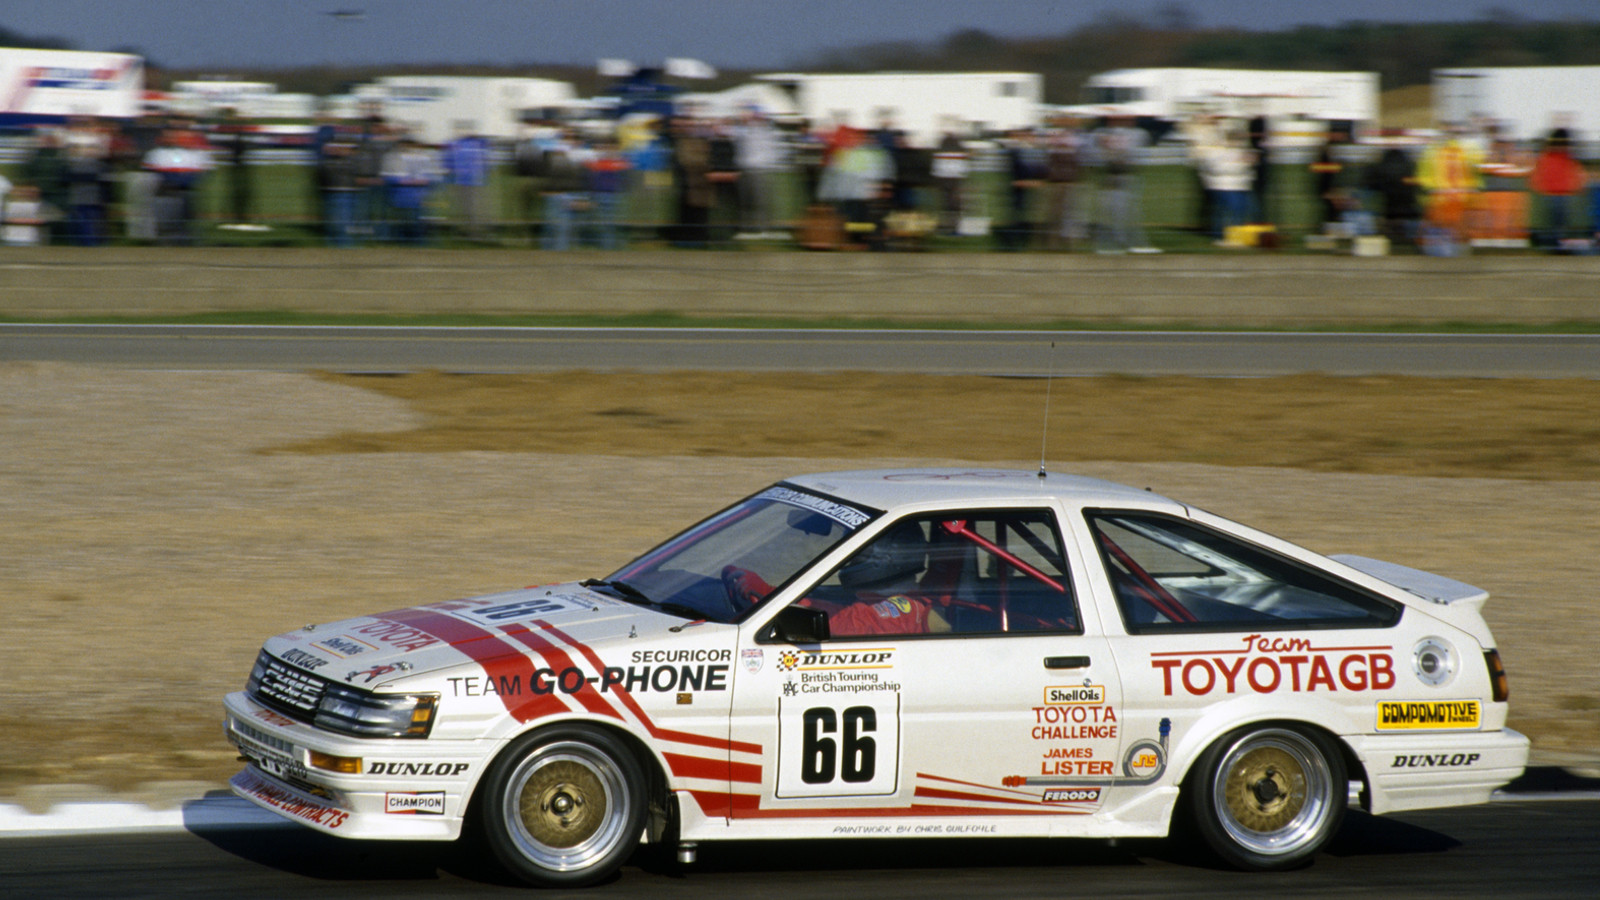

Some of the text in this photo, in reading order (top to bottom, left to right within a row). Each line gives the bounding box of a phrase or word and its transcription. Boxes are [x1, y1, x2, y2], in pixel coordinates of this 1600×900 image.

[351, 619, 440, 652] TOYOTA
[1242, 634, 1311, 652] Team
[631, 649, 731, 663] SECURICOR
[802, 653, 892, 665] DUNLOP
[447, 664, 730, 696] TEAM GO-PHONE
[801, 671, 878, 683] British Touring
[801, 682, 901, 694] Car Championship
[1032, 706, 1117, 723] TOYOTA
[1382, 703, 1477, 723] COMPOMOTIVE
[1031, 726, 1117, 739] CHALLENGE
[801, 705, 877, 784] 66
[1043, 748, 1093, 758] JAMES
[1391, 753, 1480, 767] DUNLOP
[367, 762, 469, 776] DUNLOP
[1041, 761, 1114, 775] LISTER
[389, 797, 441, 808] CHAMPION
[1044, 790, 1098, 801] FERODO
[281, 797, 349, 829] CONTRACTS
[833, 825, 892, 833] PAINTWORK
[915, 825, 942, 833] CHRIS
